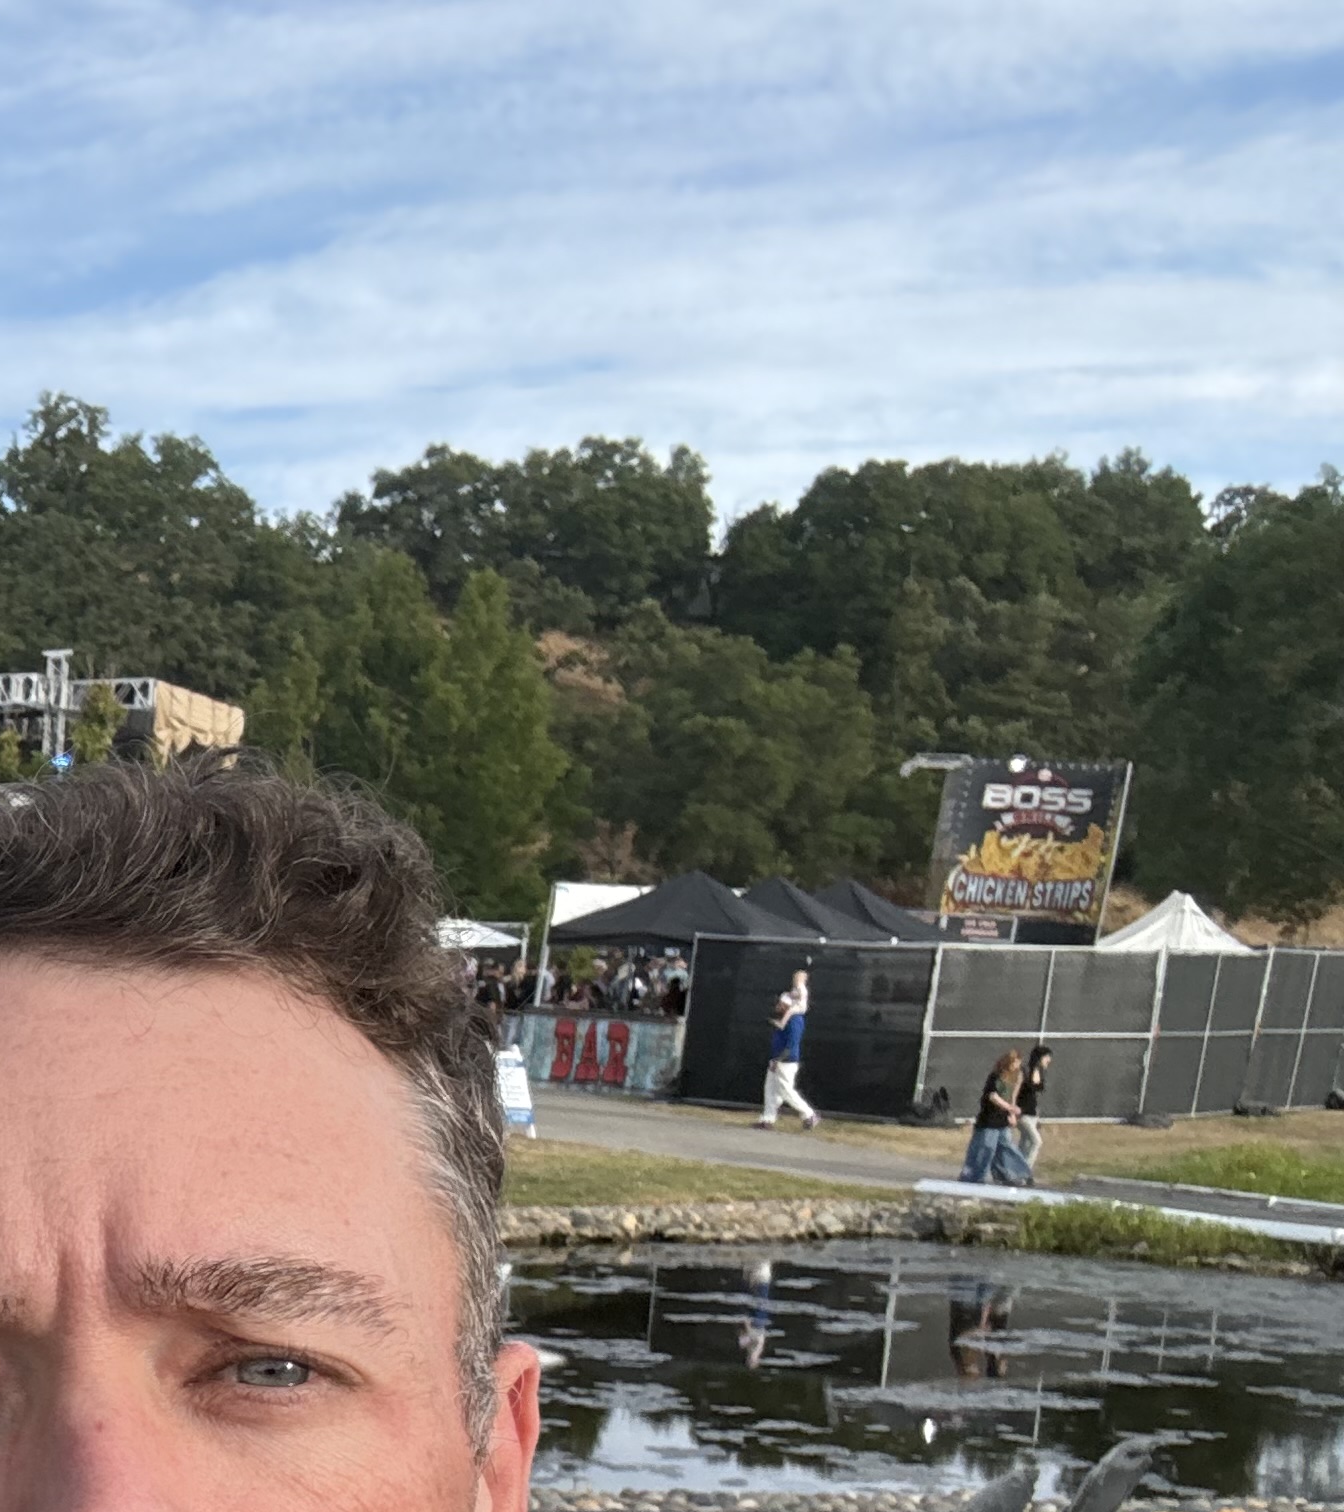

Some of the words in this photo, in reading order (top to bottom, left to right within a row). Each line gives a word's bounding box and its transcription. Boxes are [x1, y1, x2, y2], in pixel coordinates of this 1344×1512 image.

[981, 782, 1094, 815] BOSS
[952, 873, 1029, 907] CHICKEN
[1031, 878, 1093, 911] STRIPS
[548, 1016, 631, 1086] BAR
